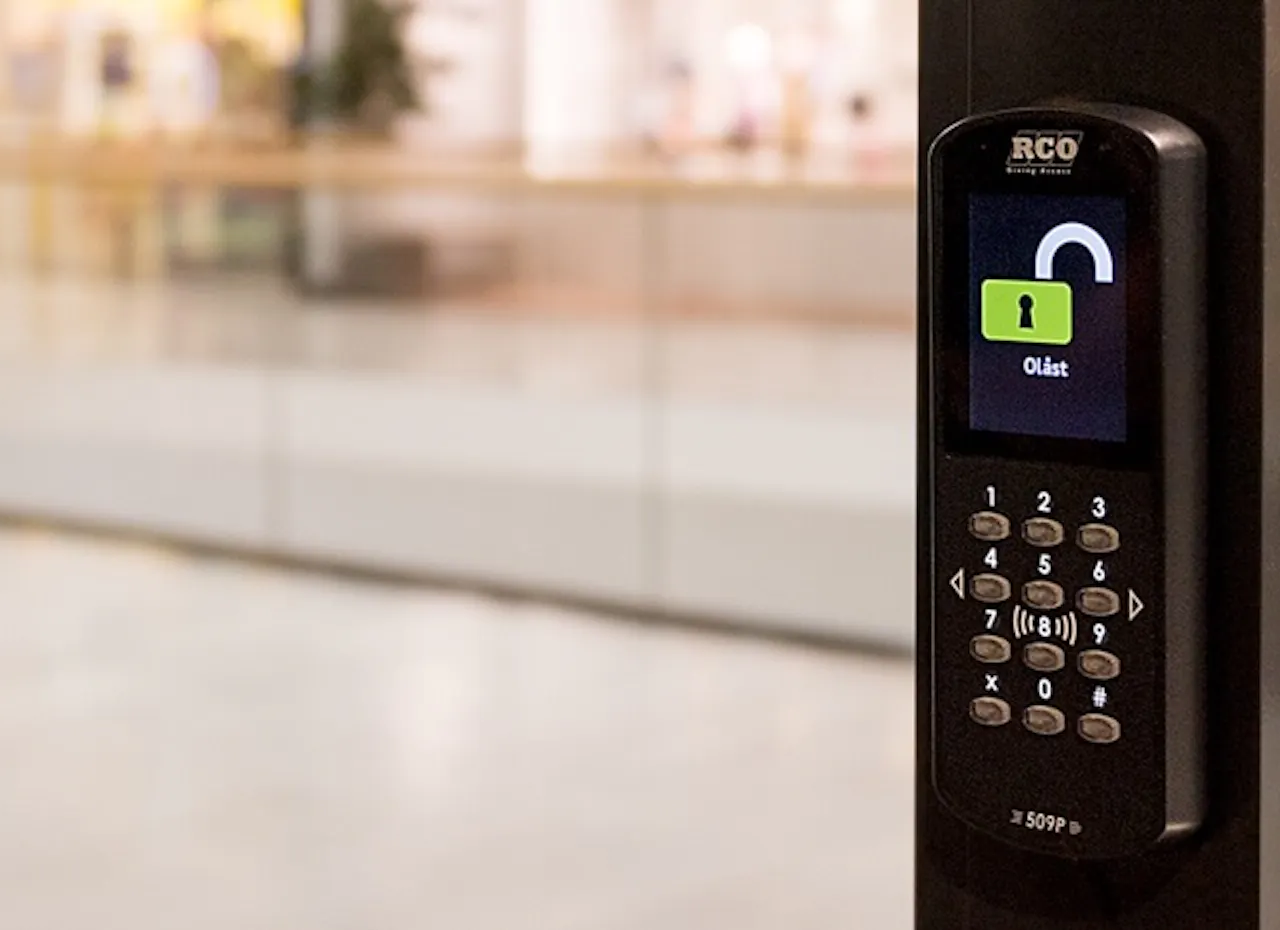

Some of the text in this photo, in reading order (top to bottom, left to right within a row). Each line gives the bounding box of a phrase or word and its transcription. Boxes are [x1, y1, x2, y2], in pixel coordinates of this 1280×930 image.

[1011, 136, 1079, 160] RCO
[1022, 356, 1069, 378] Olåst
[987, 486, 1106, 518] 1 2 3
[984, 547, 1106, 582] 4 5 6
[985, 608, 1106, 644] 7 8 9
[1038, 678, 1052, 700] 0
[1093, 686, 1107, 708] #
[1024, 810, 1067, 834] 509P
